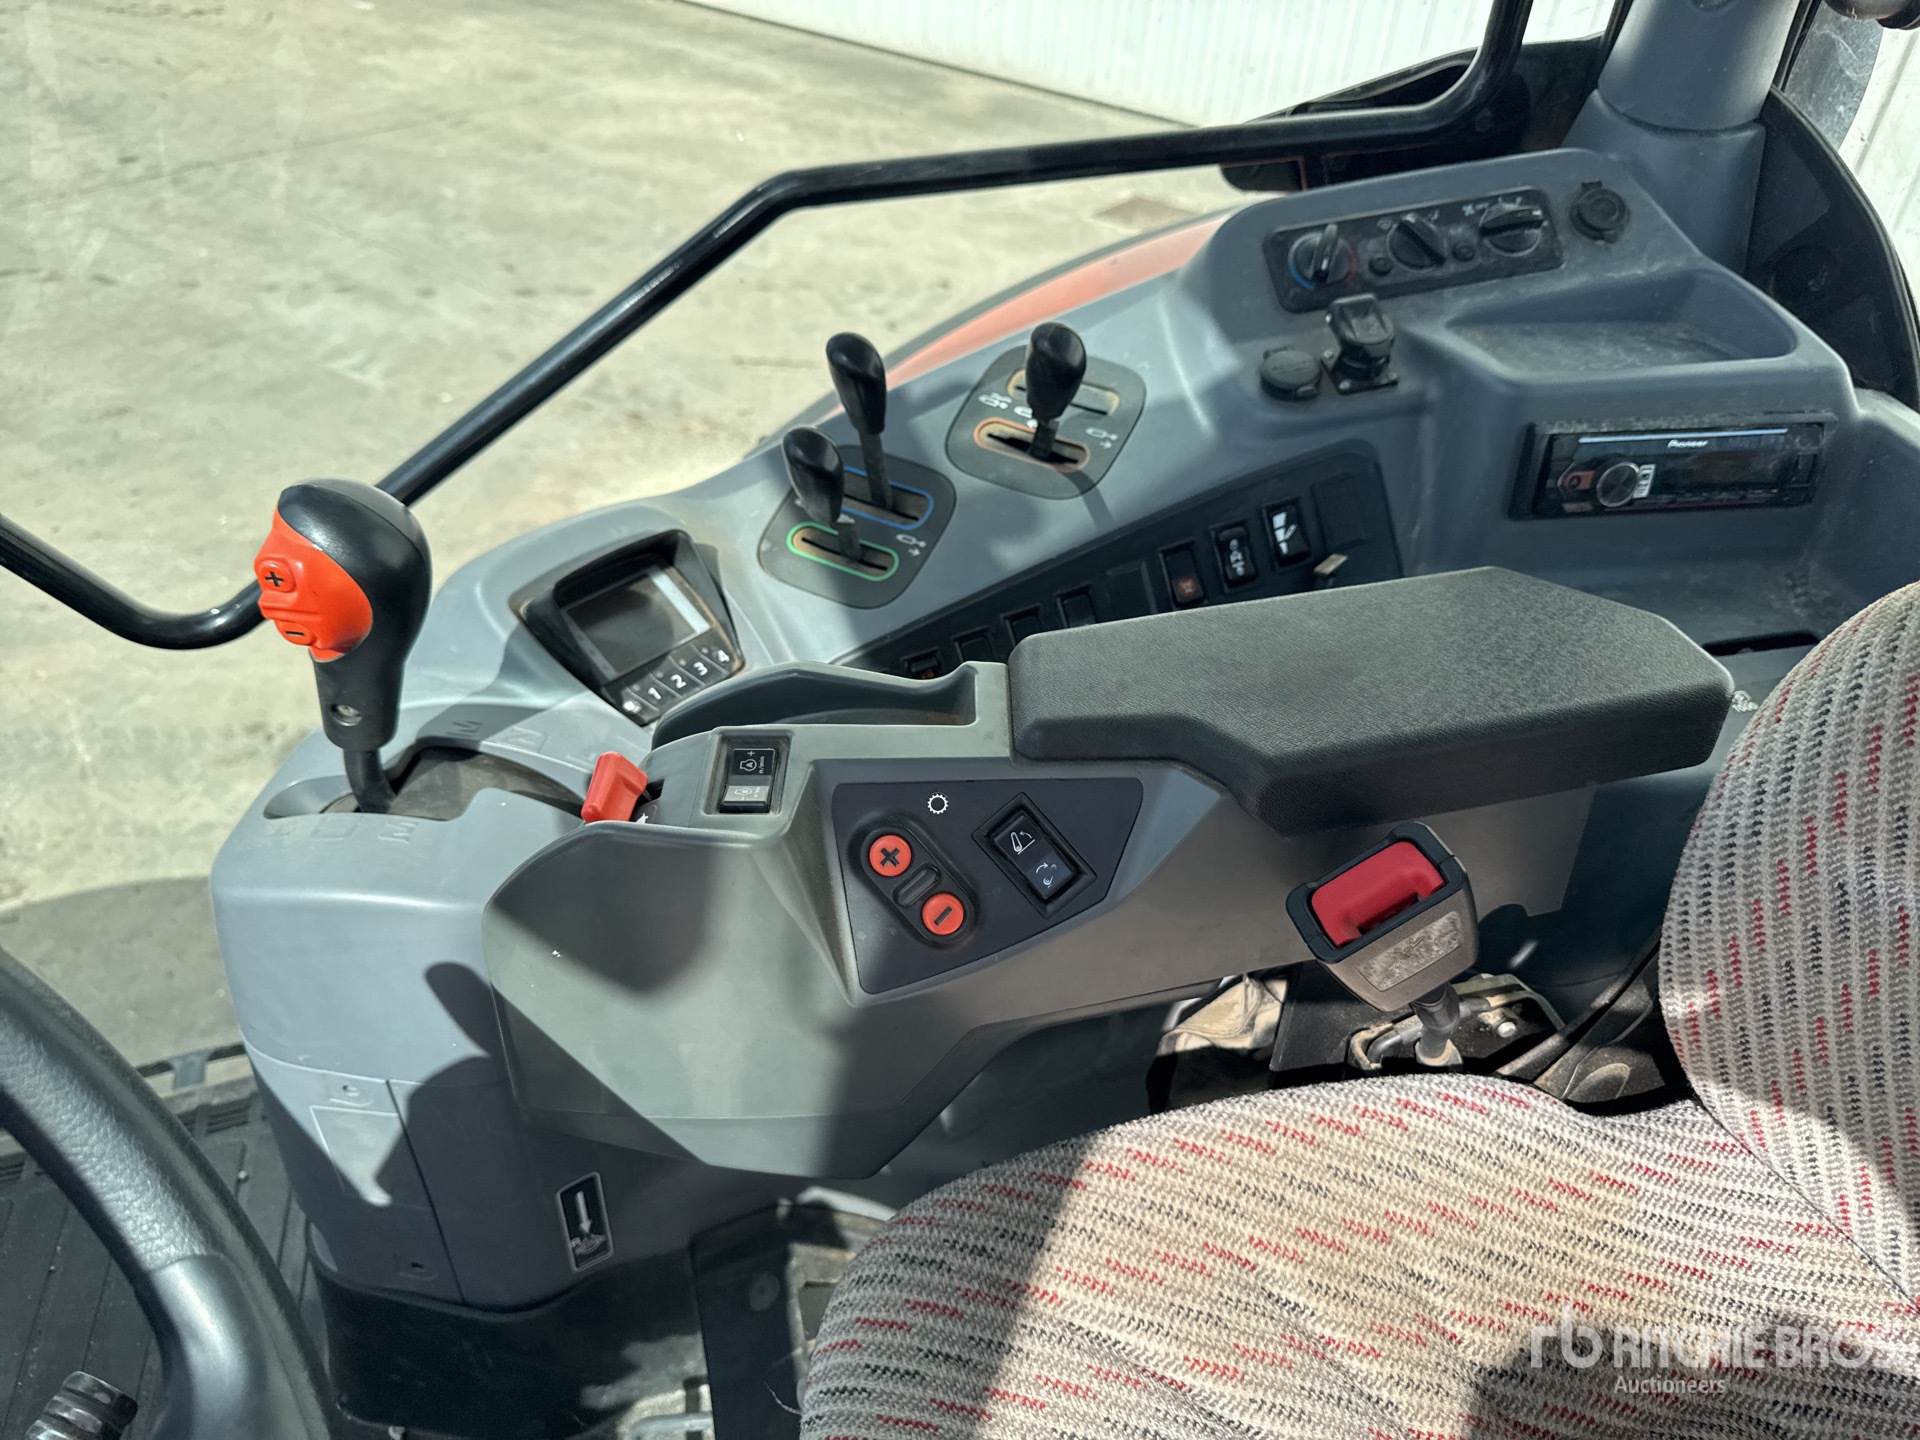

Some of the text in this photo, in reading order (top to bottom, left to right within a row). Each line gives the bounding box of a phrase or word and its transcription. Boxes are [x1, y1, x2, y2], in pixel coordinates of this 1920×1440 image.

[648, 650, 730, 701] 1 2 3 4
